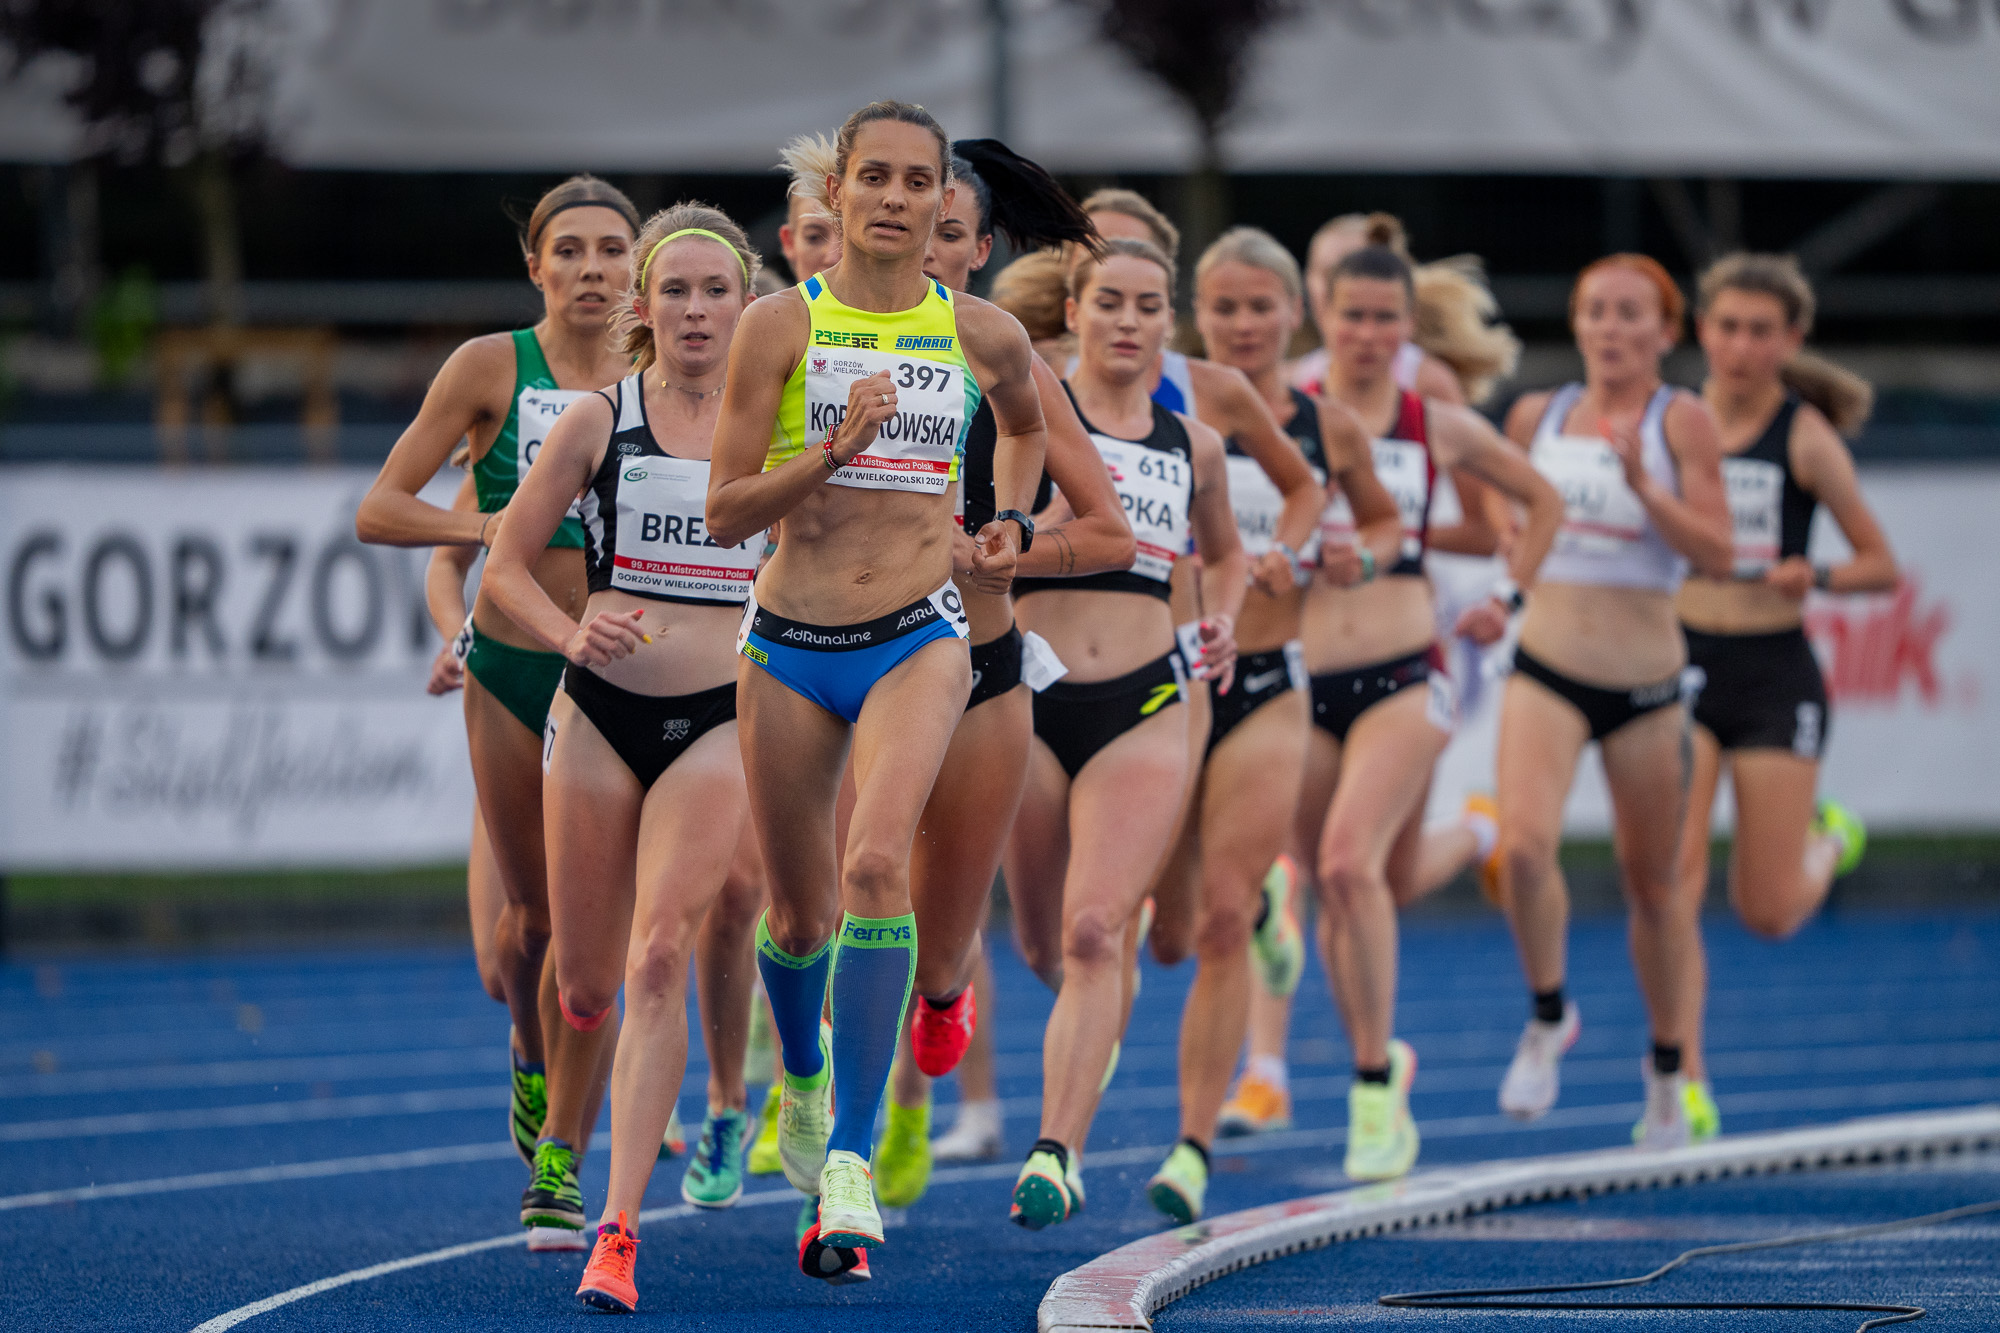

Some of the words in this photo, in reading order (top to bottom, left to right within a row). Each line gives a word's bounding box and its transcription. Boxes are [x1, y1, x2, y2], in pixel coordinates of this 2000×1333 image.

[894, 335, 955, 351] SONAROL
[832, 366, 878, 377] WIELKOPOLSK
[833, 359, 864, 369] GORZÓW
[897, 363, 951, 393] 397
[861, 457, 911, 470] Mistrzostwa
[912, 462, 934, 471] Polski
[1138, 456, 1182, 487] 611
[856, 471, 925, 485] WIELKOPOLSKI
[926, 477, 945, 486] 2023
[1119, 493, 1174, 531] PKA
[631, 560, 645, 570] 99.
[646, 562, 667, 573] PZLA
[669, 566, 724, 578] Mistrzostwa
[725, 570, 749, 579] Polski
[617, 572, 663, 586] GORZÓW
[664, 579, 737, 593] WIELKOPOLSKI
[781, 627, 872, 646] AdRunaLine
[843, 920, 911, 942] Ferrys
